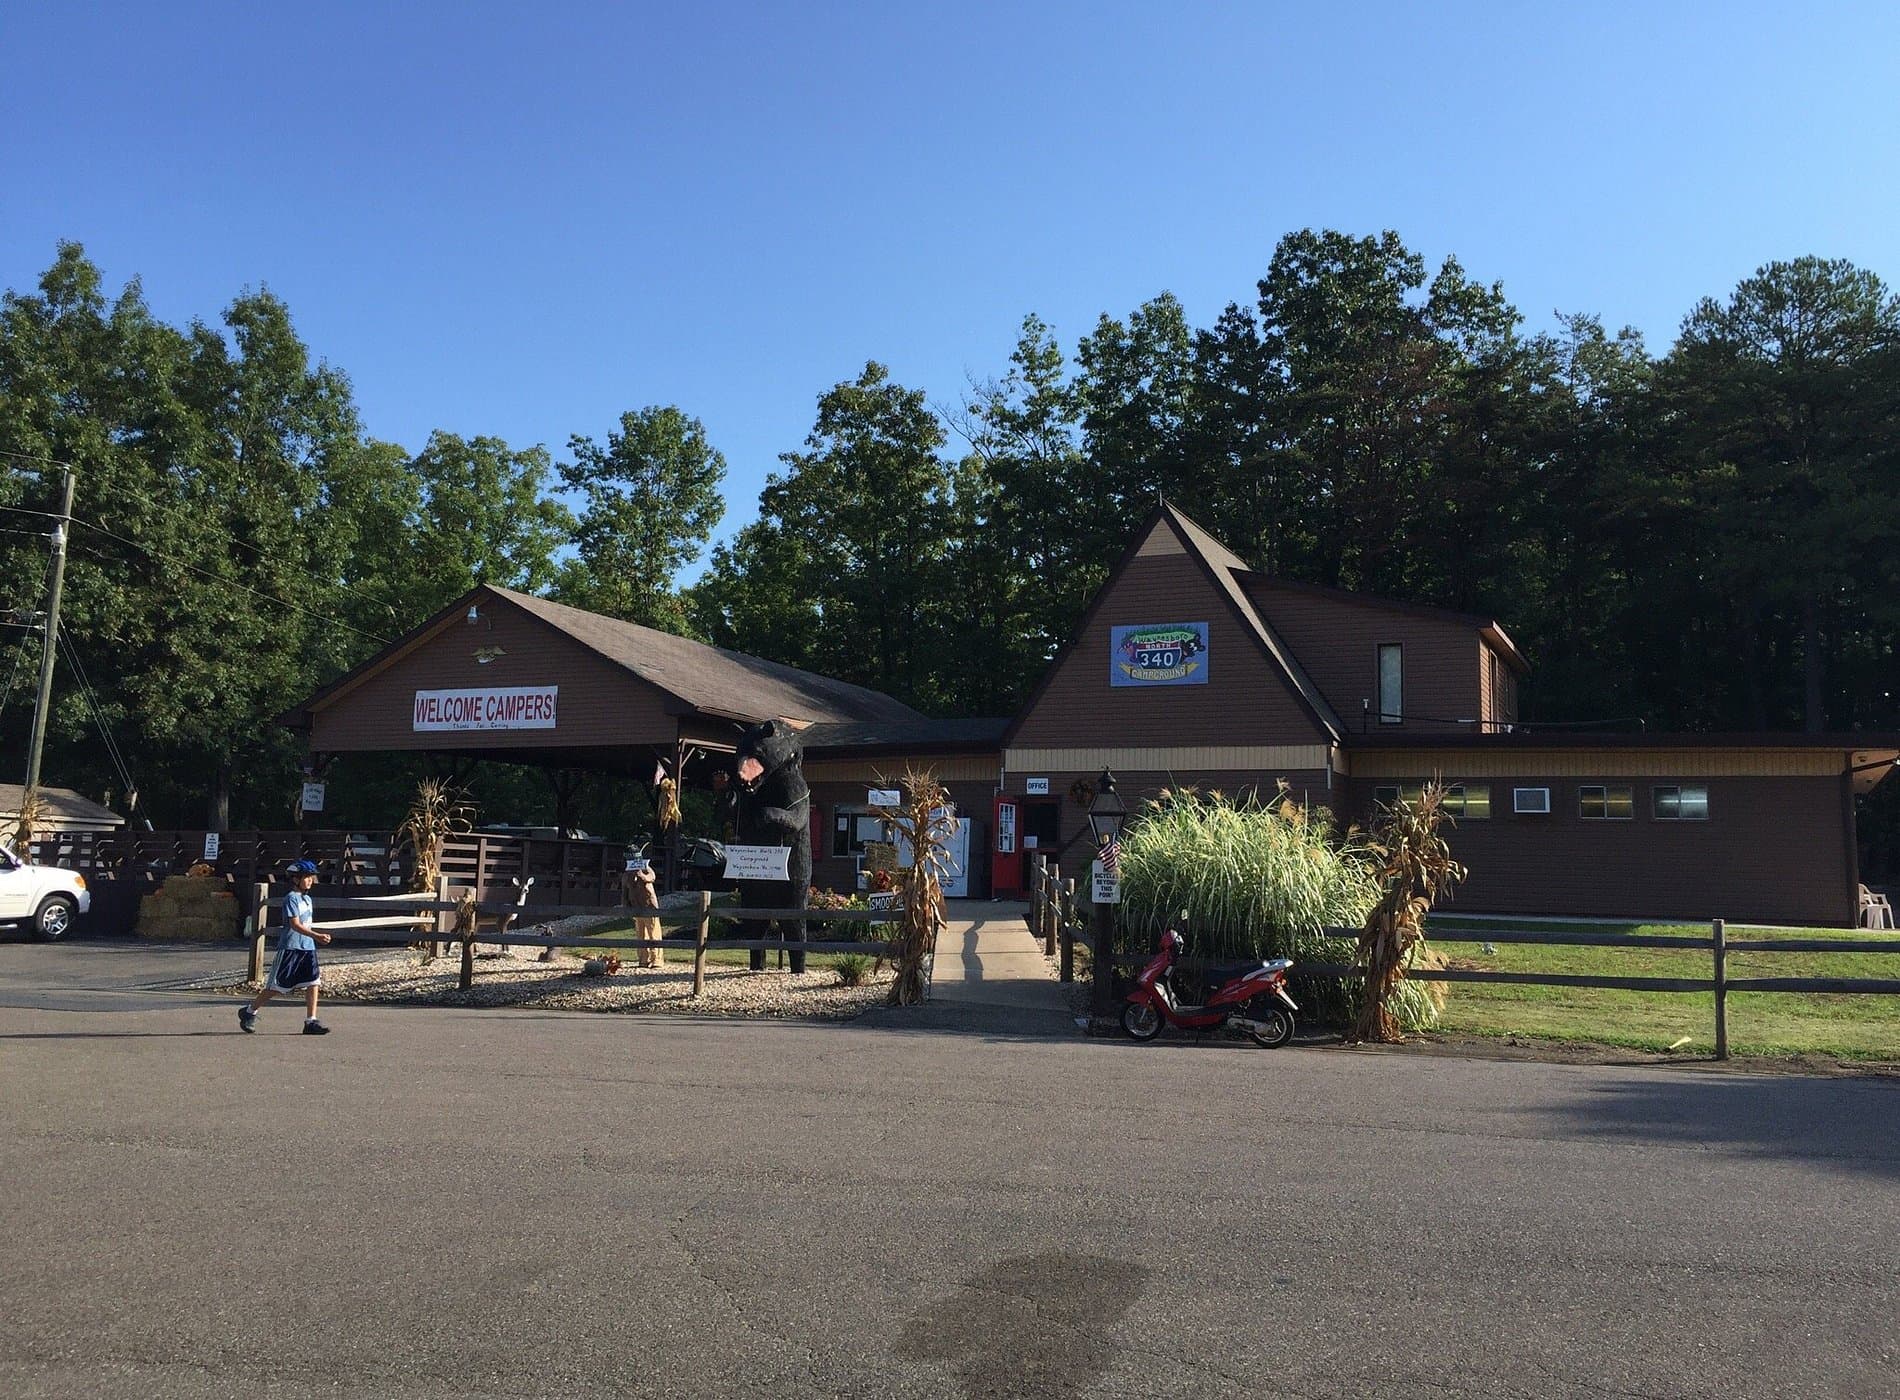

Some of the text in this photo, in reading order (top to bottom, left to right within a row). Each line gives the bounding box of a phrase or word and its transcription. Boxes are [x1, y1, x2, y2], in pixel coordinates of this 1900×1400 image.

[1140, 653, 1173, 666] 340
[1132, 666, 1186, 680] CAMPGROUND
[416, 694, 557, 723] WELCOME CAMPERS!
